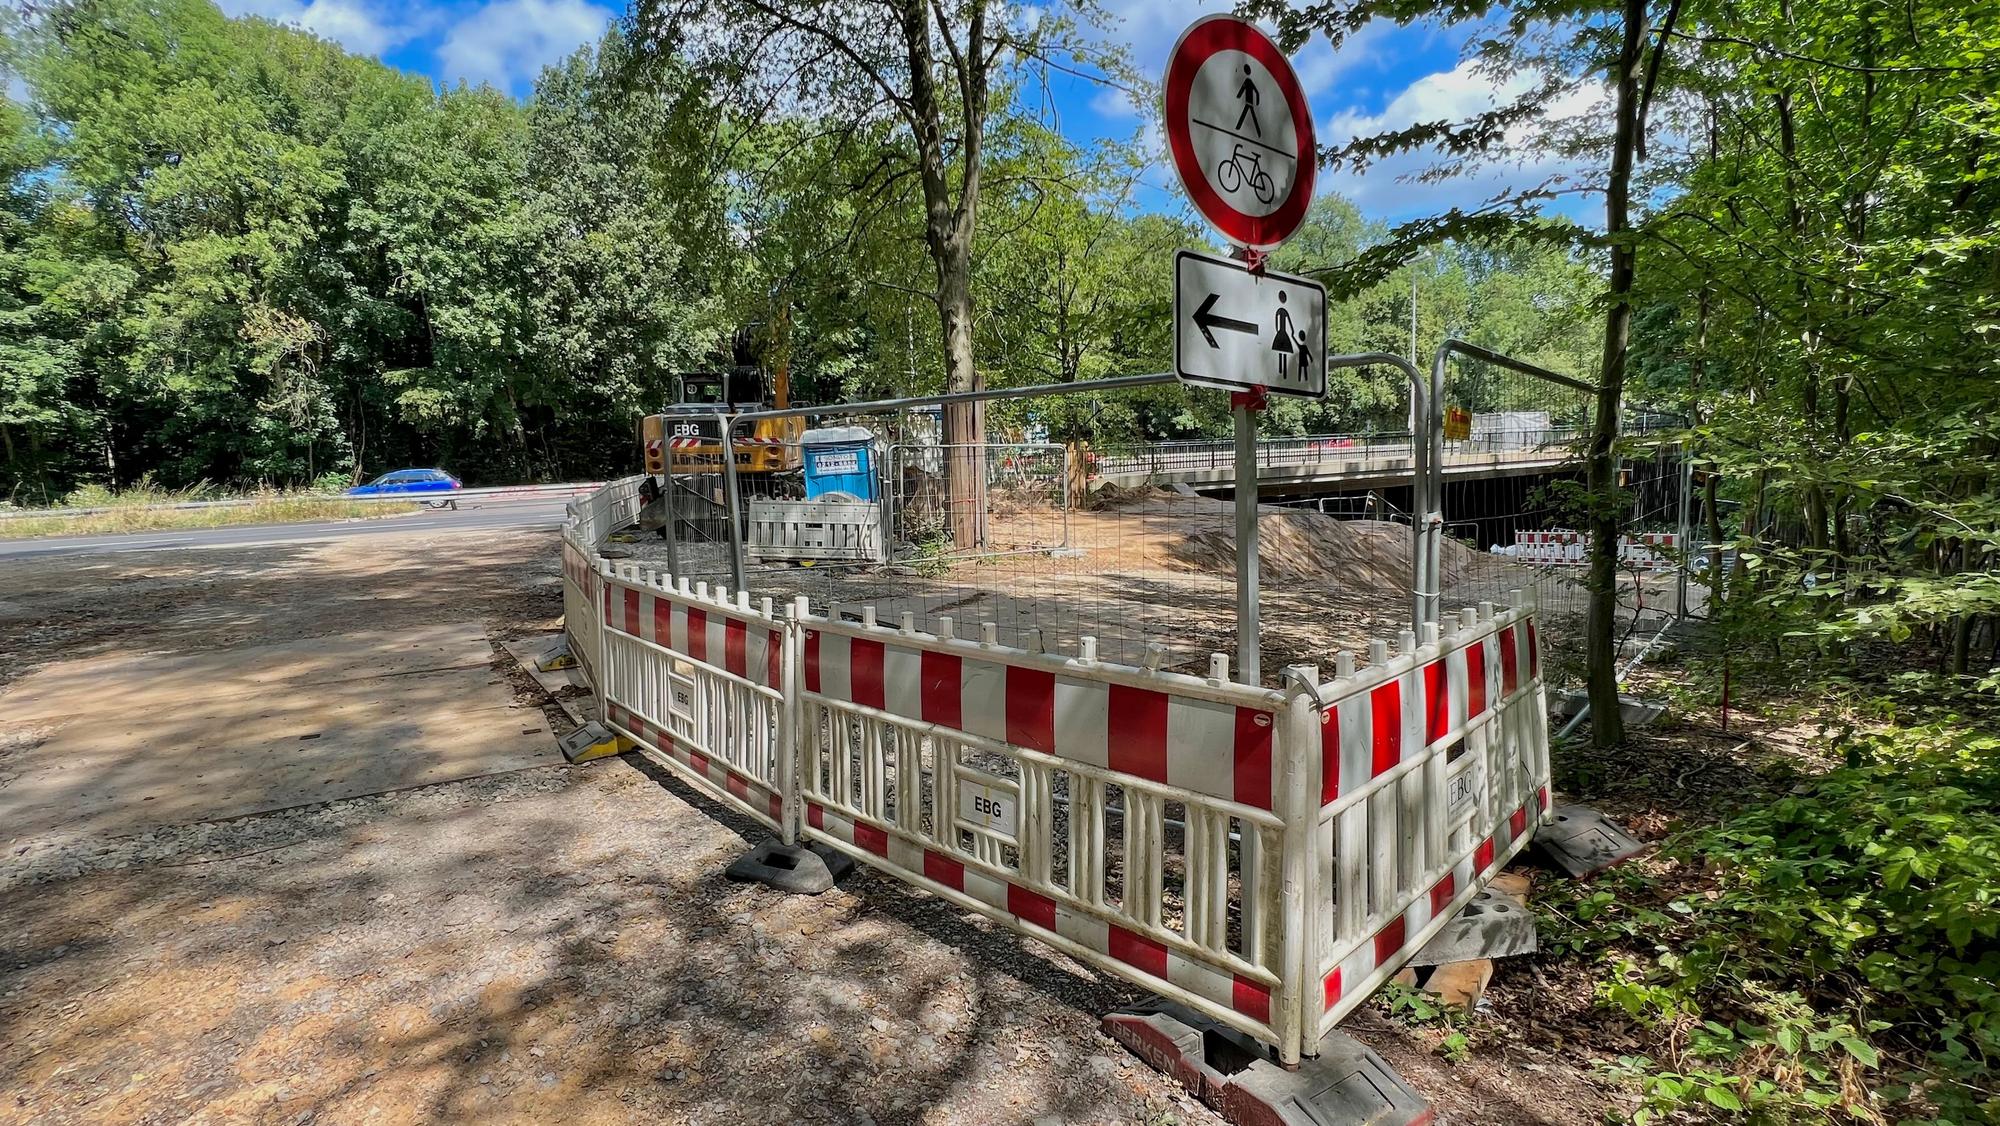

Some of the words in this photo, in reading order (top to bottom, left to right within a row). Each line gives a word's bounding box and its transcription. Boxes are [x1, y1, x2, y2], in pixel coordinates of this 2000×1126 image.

[674, 424, 700, 436] EBG
[677, 691, 689, 705] EBG
[1449, 771, 1472, 806] EBG
[975, 796, 1002, 818] EBG
[1112, 1020, 1177, 1075] GERKEN
